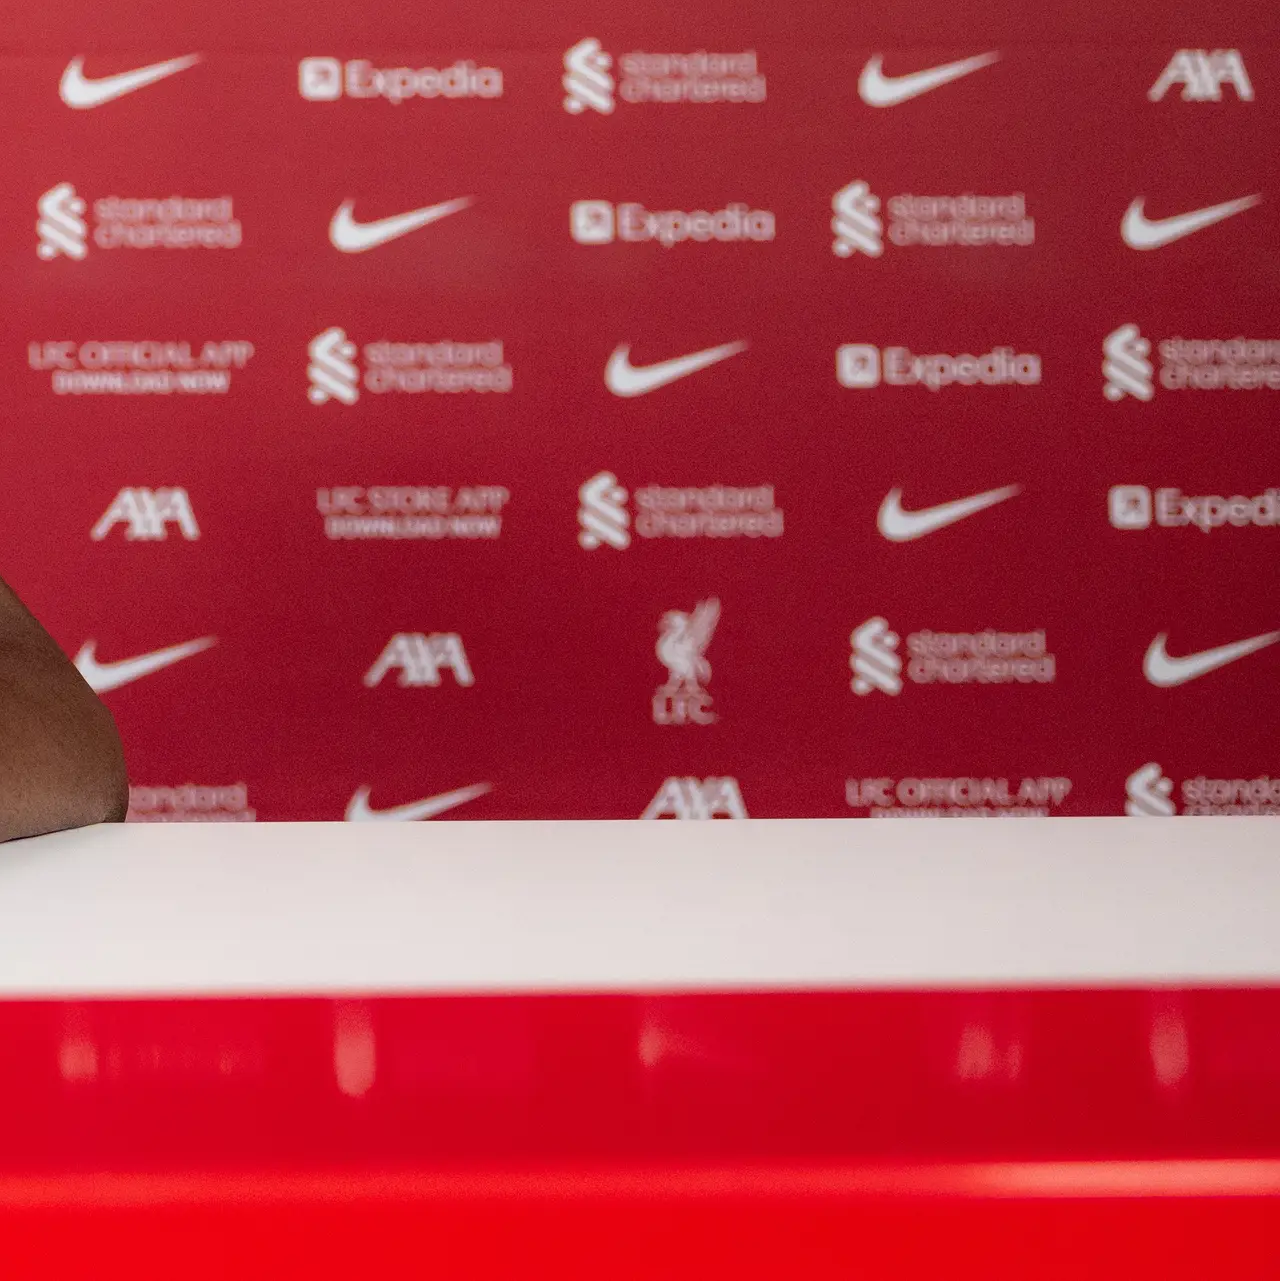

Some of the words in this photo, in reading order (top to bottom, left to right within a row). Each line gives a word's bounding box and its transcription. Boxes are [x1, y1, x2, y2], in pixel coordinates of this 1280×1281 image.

[343, 60, 503, 102] Expedia
[1150, 50, 1253, 100] AXA
[615, 203, 776, 246] Expedia
[881, 347, 1041, 390] Expedia
[93, 488, 198, 539] AXA
[366, 634, 473, 686] AXA
